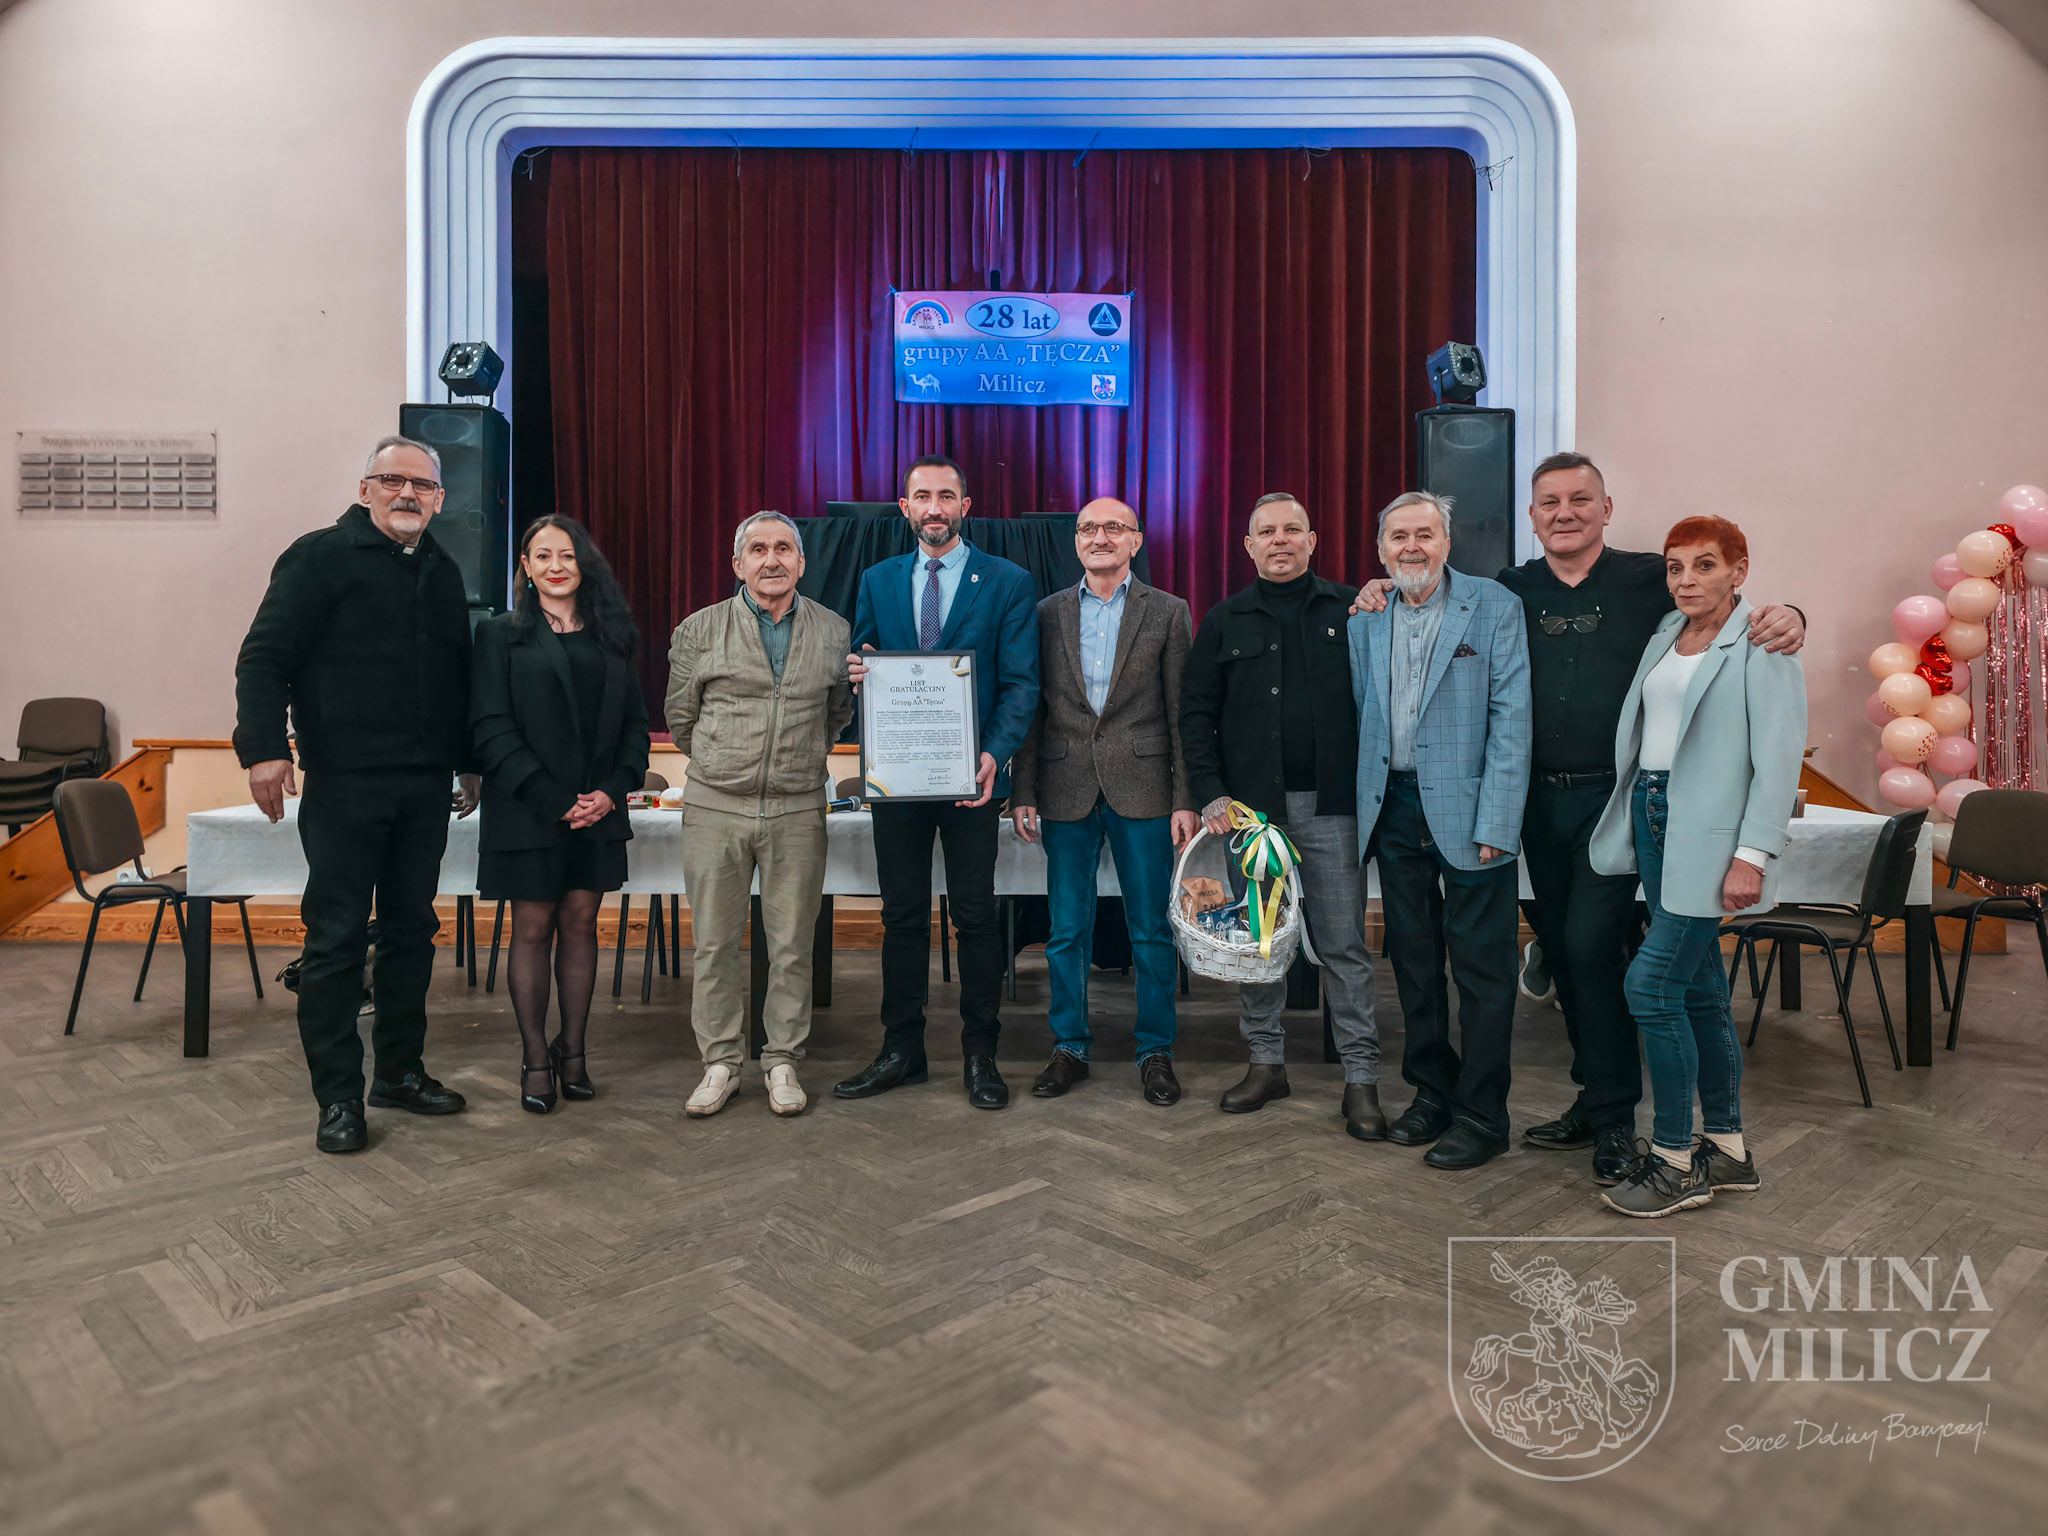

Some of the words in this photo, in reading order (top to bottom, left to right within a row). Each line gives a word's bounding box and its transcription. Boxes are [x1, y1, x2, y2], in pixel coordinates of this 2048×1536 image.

[978, 303, 1014, 329] 28
[1022, 309, 1051, 330] lat
[904, 345, 969, 366] grupy
[974, 342, 1010, 361] AA
[1016, 342, 1121, 367] „TĘCZA”
[977, 373, 1047, 393] Milicz
[891, 699, 912, 707] Grupy
